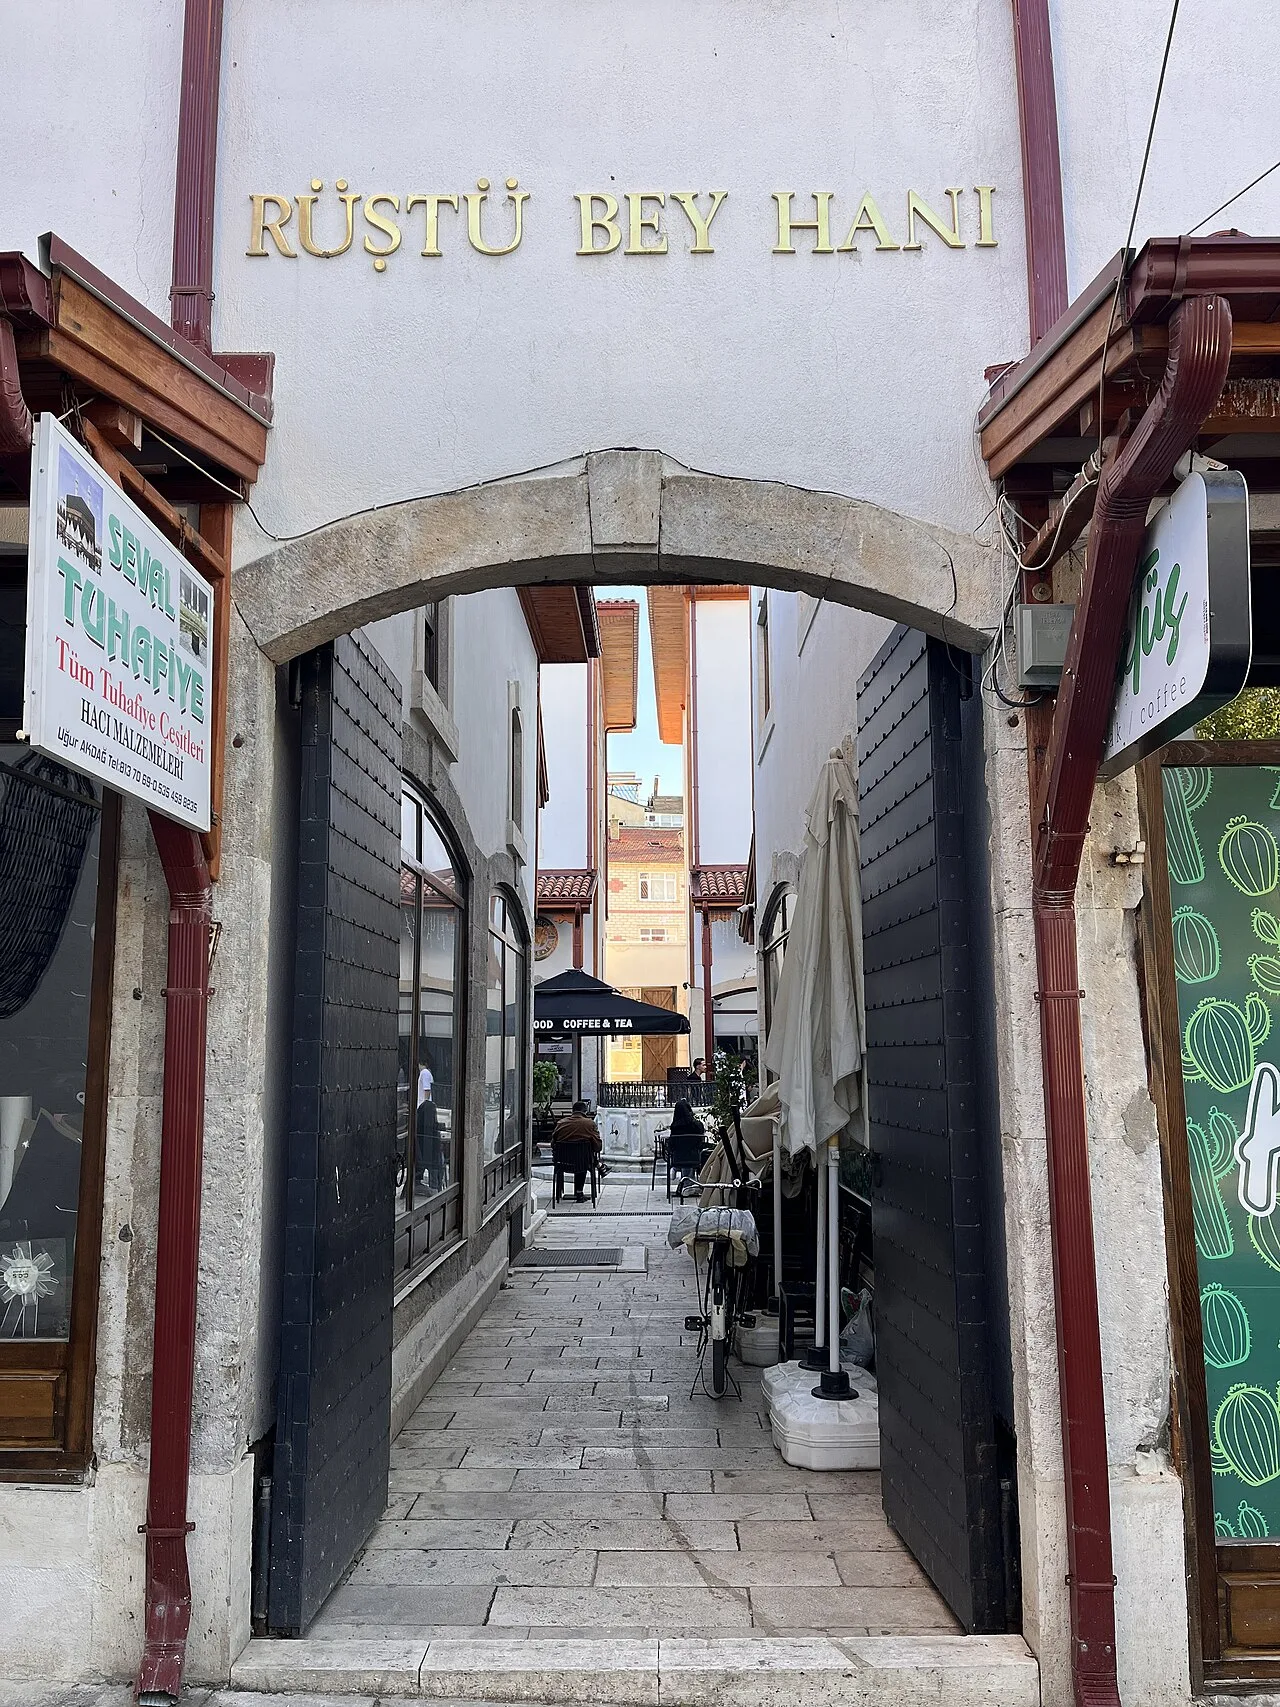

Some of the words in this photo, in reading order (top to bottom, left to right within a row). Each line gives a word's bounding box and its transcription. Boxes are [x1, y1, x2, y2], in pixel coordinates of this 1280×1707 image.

[246, 177, 530, 272] RÜŞTÜ
[573, 191, 728, 256] BEY
[771, 186, 999, 255] HANI
[108, 513, 175, 622] SEVAL
[57, 556, 205, 724] TUHAFİYE
[55, 635, 95, 692] Tüm
[99, 667, 156, 731] Tuhafiye
[159, 711, 205, 763] Çeşitleri
[80, 697, 111, 737] HACI
[113, 717, 184, 781] MALZEMELERİ
[1140, 676, 1187, 724] coffee
[57, 726, 79, 748] Uğur
[80, 739, 107, 763] AKDAĞ
[132, 767, 141, 782] 70
[170, 790, 183, 806] 459
[183, 798, 198, 814] 8235
[533, 1020, 554, 1029] OOD
[563, 1019, 600, 1029] COFFEE
[602, 1019, 611, 1028] &
[614, 1019, 633, 1028] TEA
